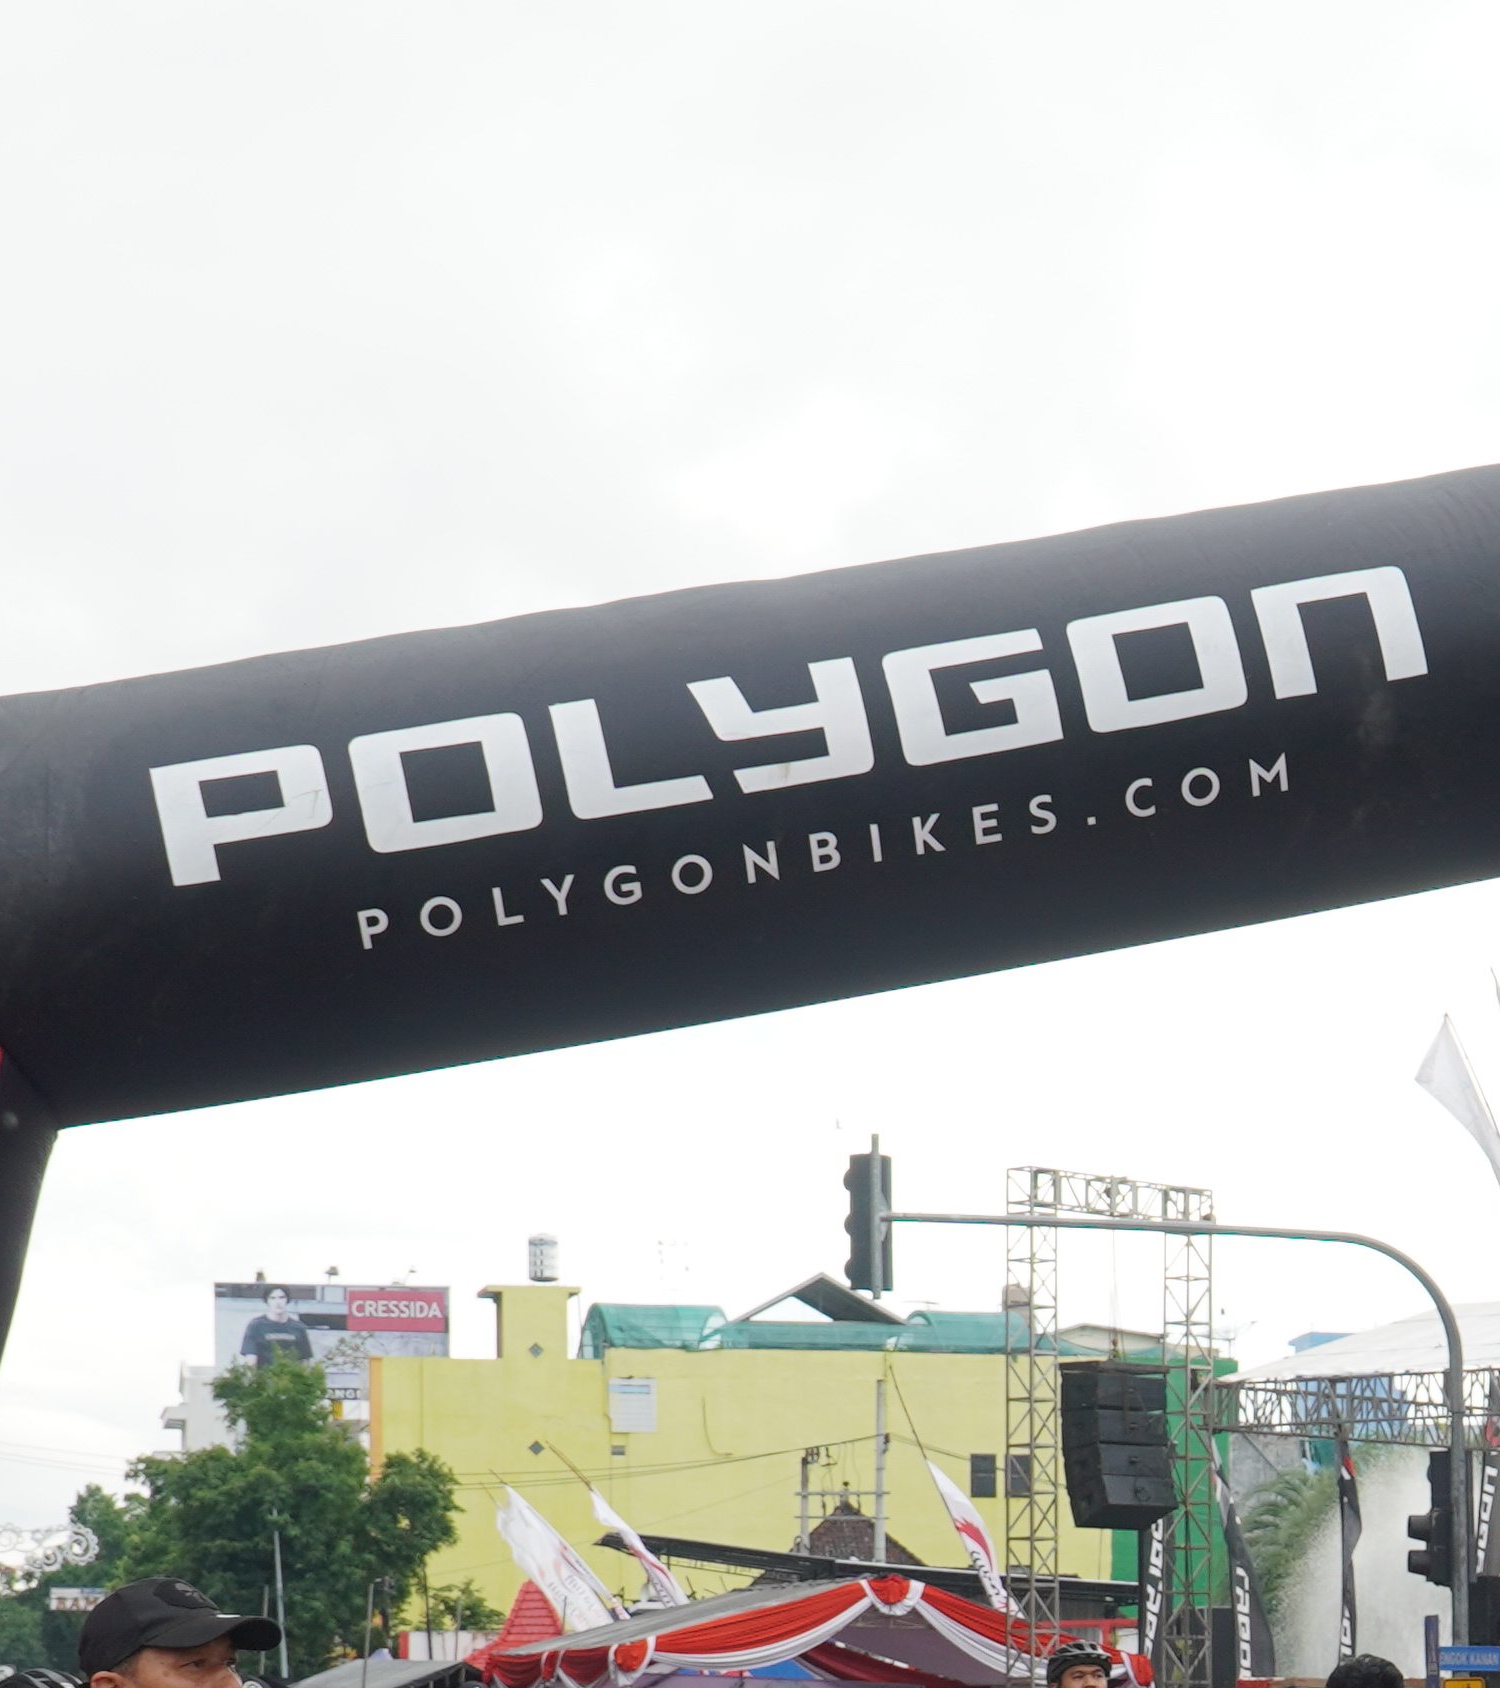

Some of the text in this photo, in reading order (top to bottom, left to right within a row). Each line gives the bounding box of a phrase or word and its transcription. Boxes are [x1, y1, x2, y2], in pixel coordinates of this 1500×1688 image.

[149, 565, 1428, 887] POLYGON
[357, 753, 1292, 950] POLYGONBIKES.COM
[351, 1300, 443, 1319] CRESSIDA
